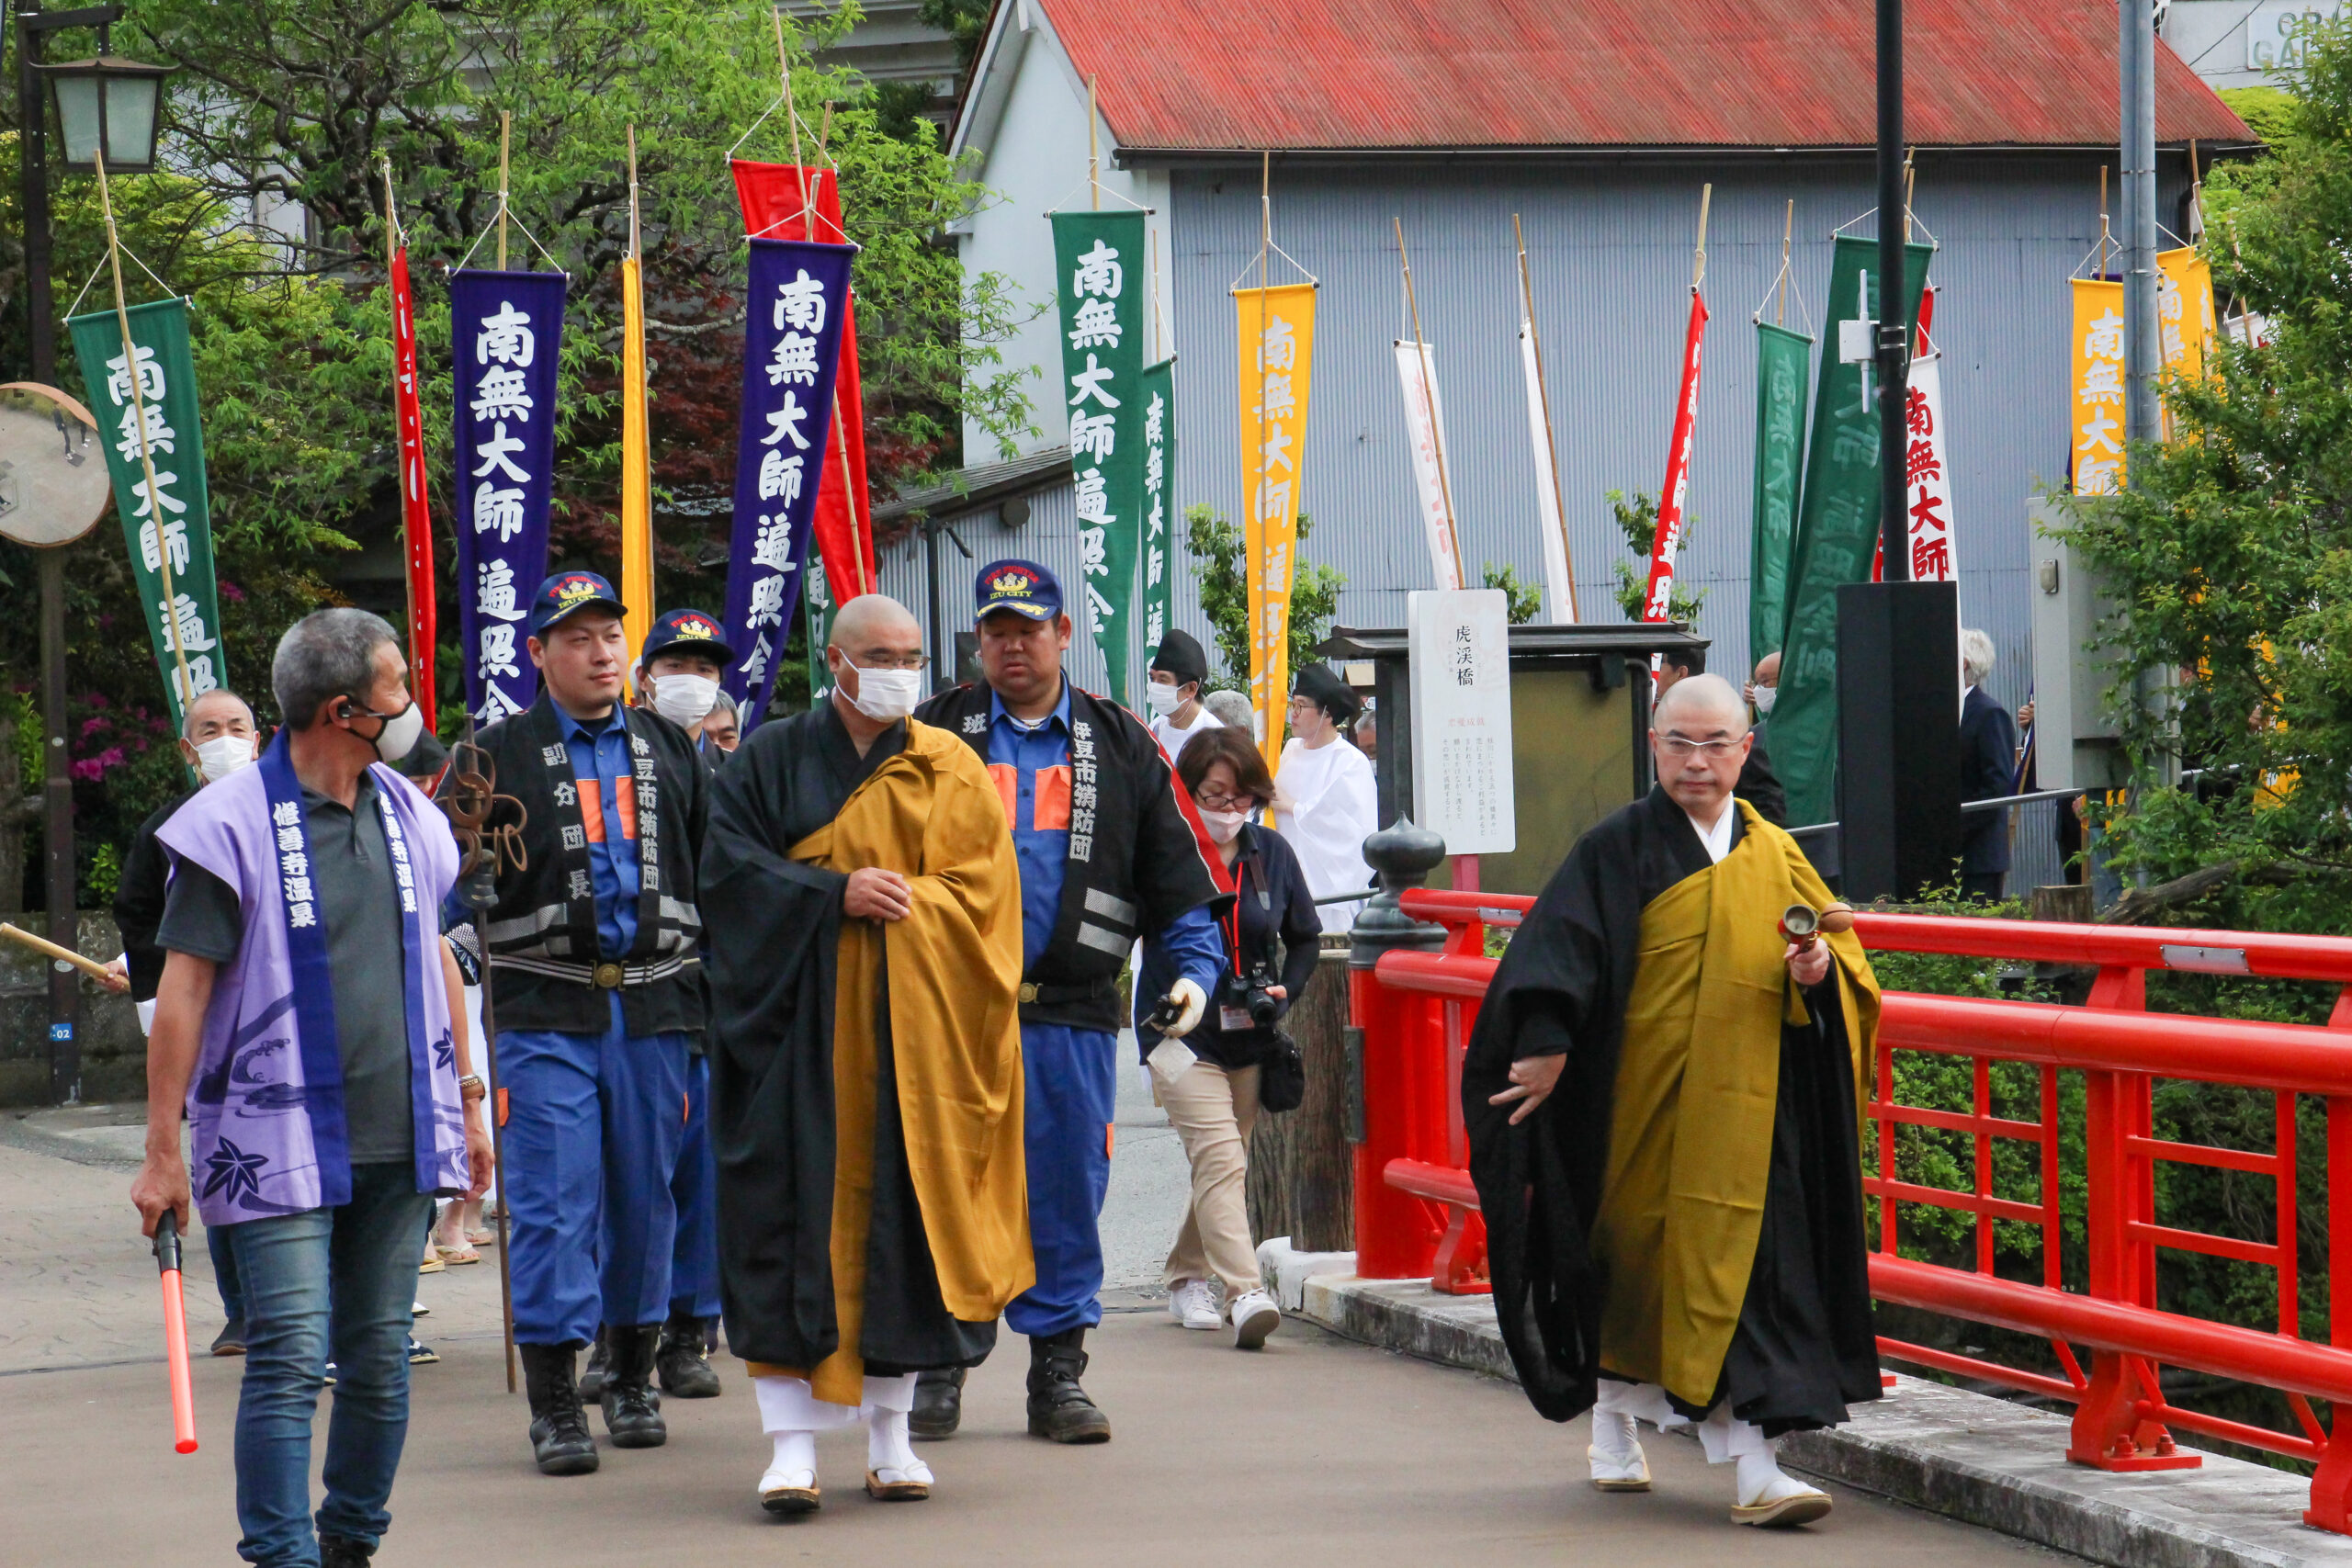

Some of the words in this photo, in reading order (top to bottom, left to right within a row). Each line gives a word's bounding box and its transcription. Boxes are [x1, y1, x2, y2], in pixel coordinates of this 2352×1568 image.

[1069, 239, 1123, 671] 南無大師遍照金
[989, 592, 1005, 600] IZU
[1455, 625, 1474, 686] 虎渓橋
[962, 713, 988, 734] 班
[1069, 717, 1098, 863] 伊豆市消防団
[541, 742, 592, 900] 副分団長
[631, 733, 660, 891] 伊豆市消防団
